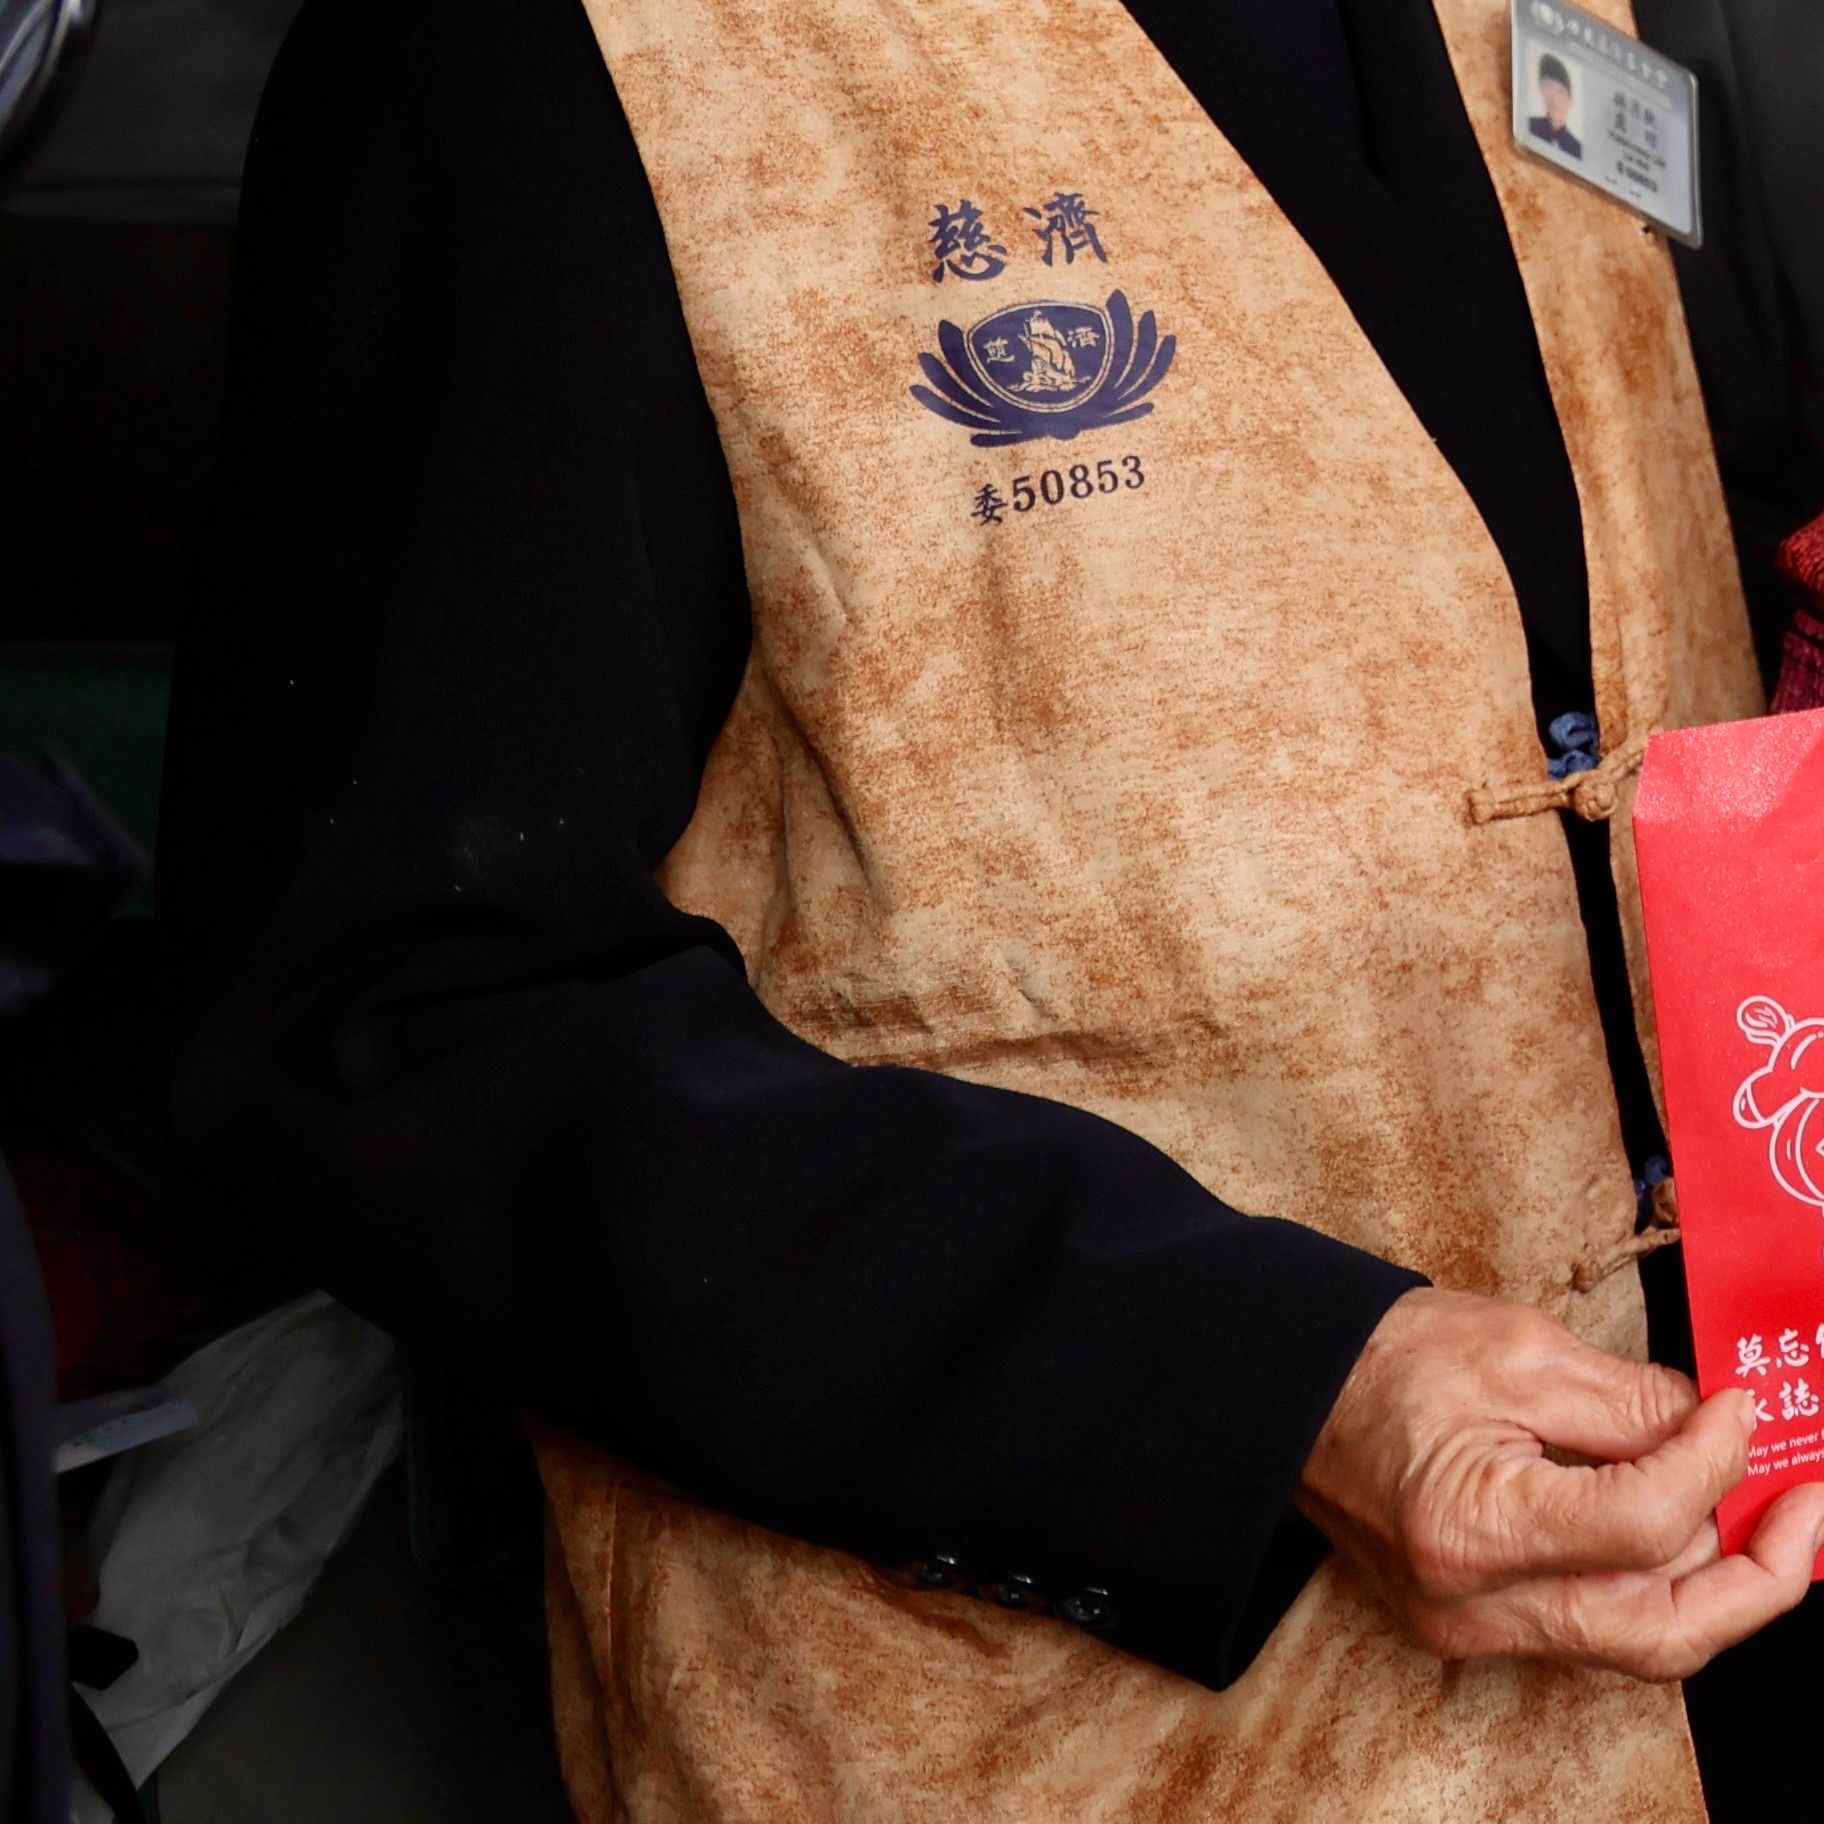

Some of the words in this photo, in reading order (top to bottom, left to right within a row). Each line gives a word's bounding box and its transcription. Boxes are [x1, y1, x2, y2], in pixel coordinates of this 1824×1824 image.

[928, 192, 1109, 284] 慈濟
[971, 455, 1146, 526] 委50853
[1771, 1440, 1787, 1452] we
[1789, 1432, 1818, 1448] never
[1747, 1462, 1770, 1477] May
[1773, 1457, 1790, 1470] we
